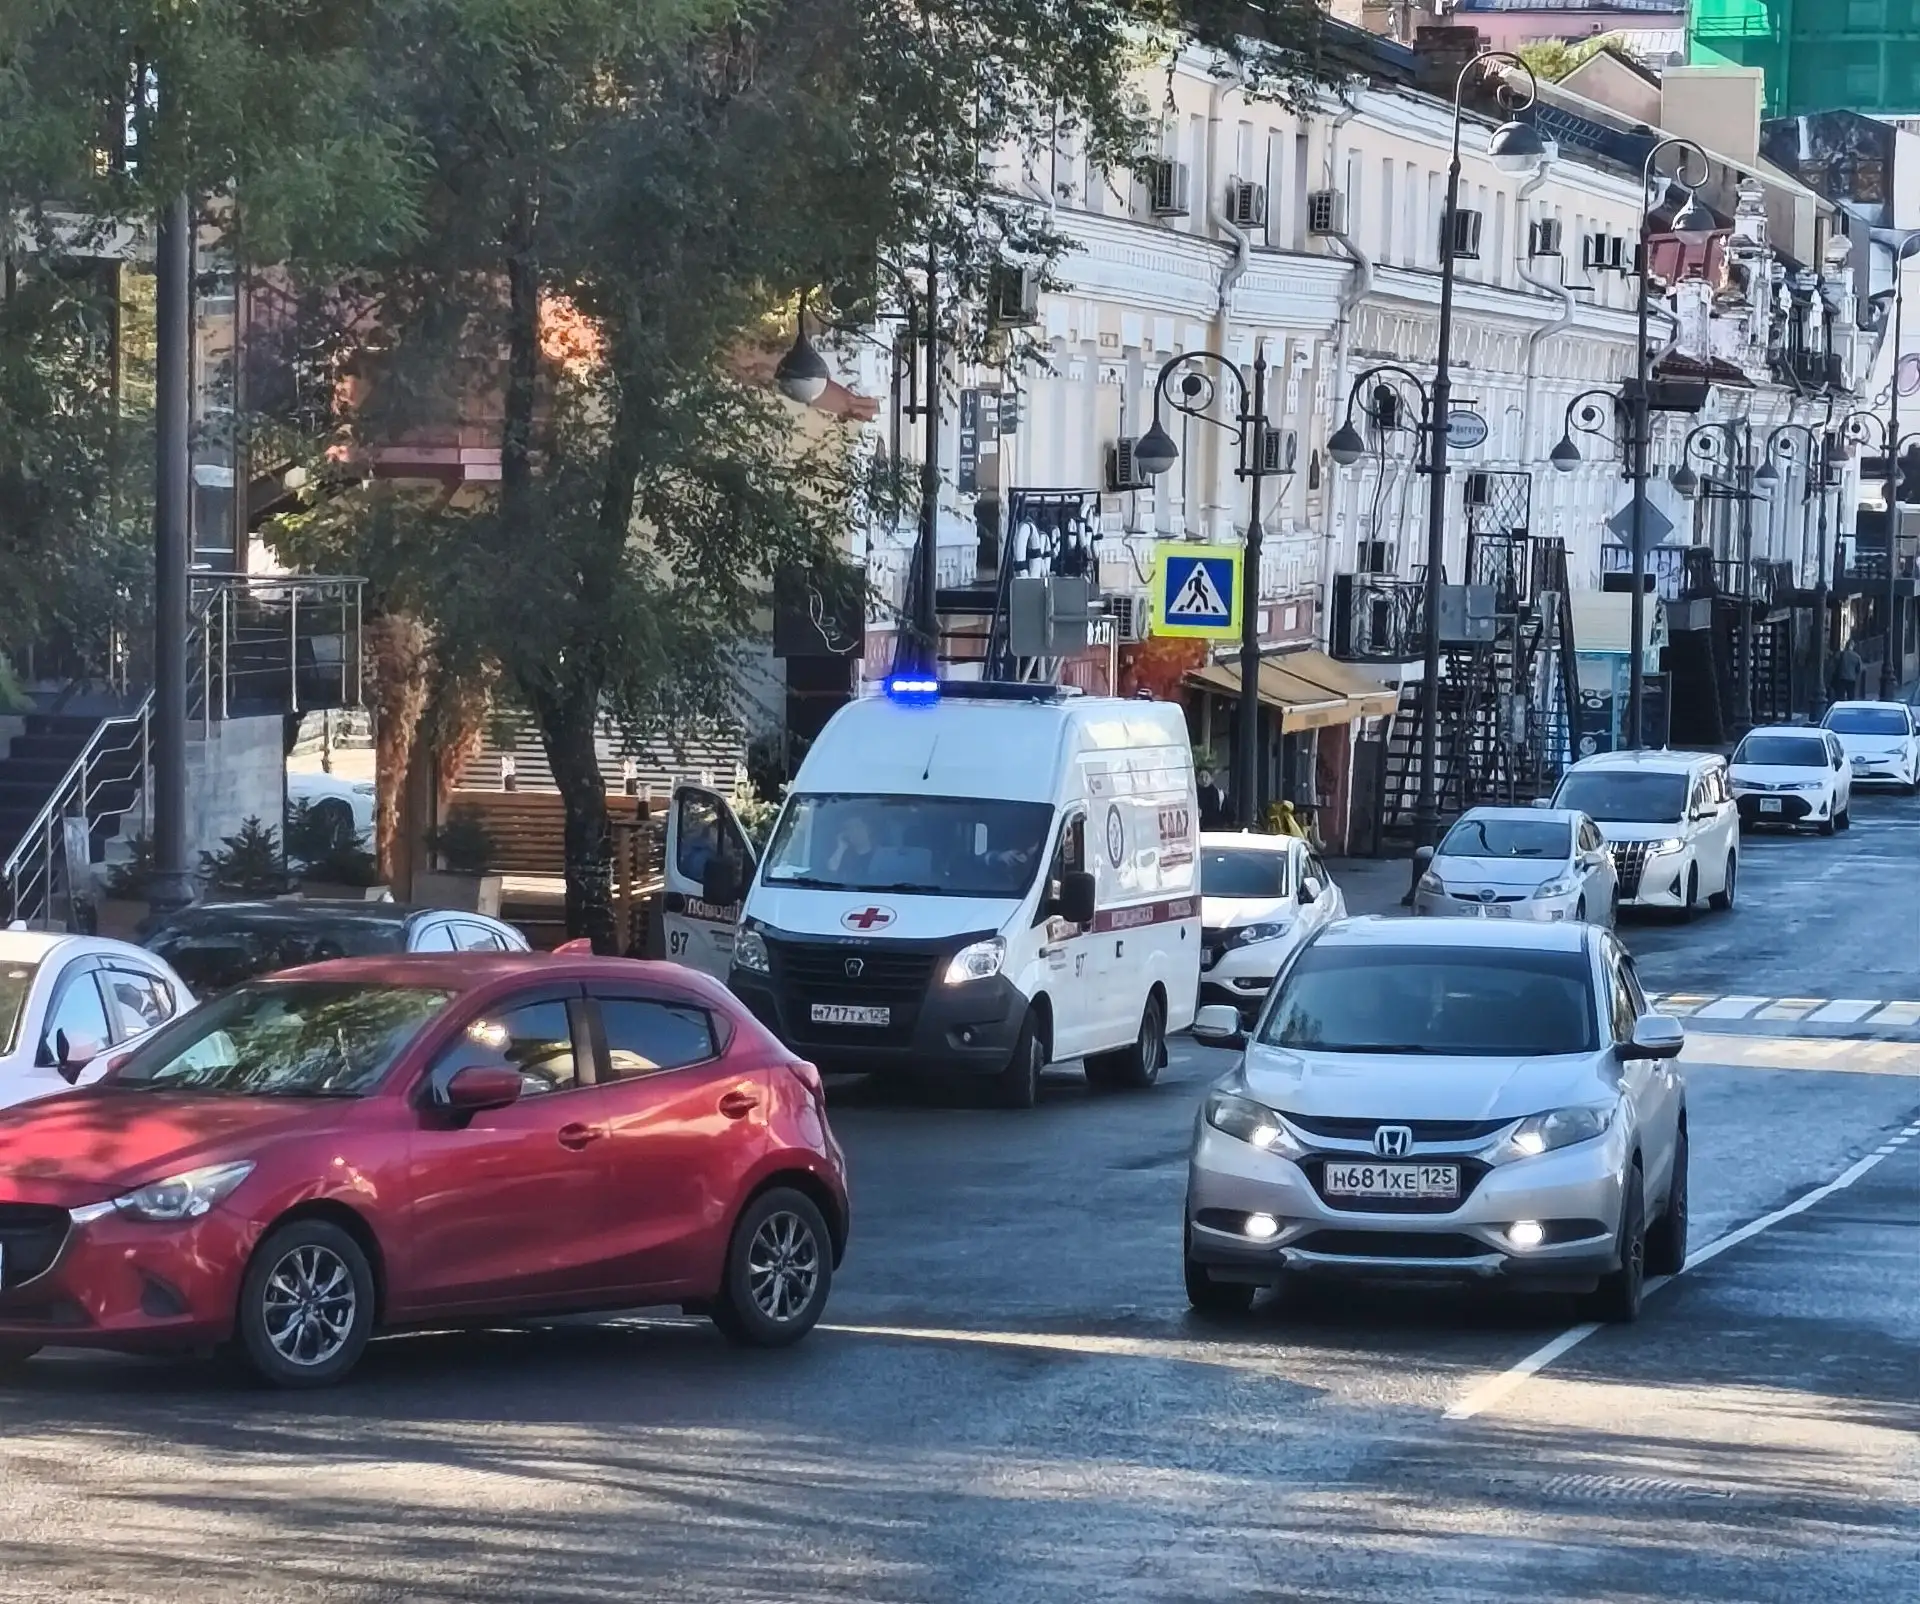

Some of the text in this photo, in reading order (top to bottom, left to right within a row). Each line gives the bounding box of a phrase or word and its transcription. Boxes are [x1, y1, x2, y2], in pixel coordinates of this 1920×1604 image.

[670, 930, 689, 955] 97
[1333, 1167, 1453, 1189] Н681ХЕ 125
